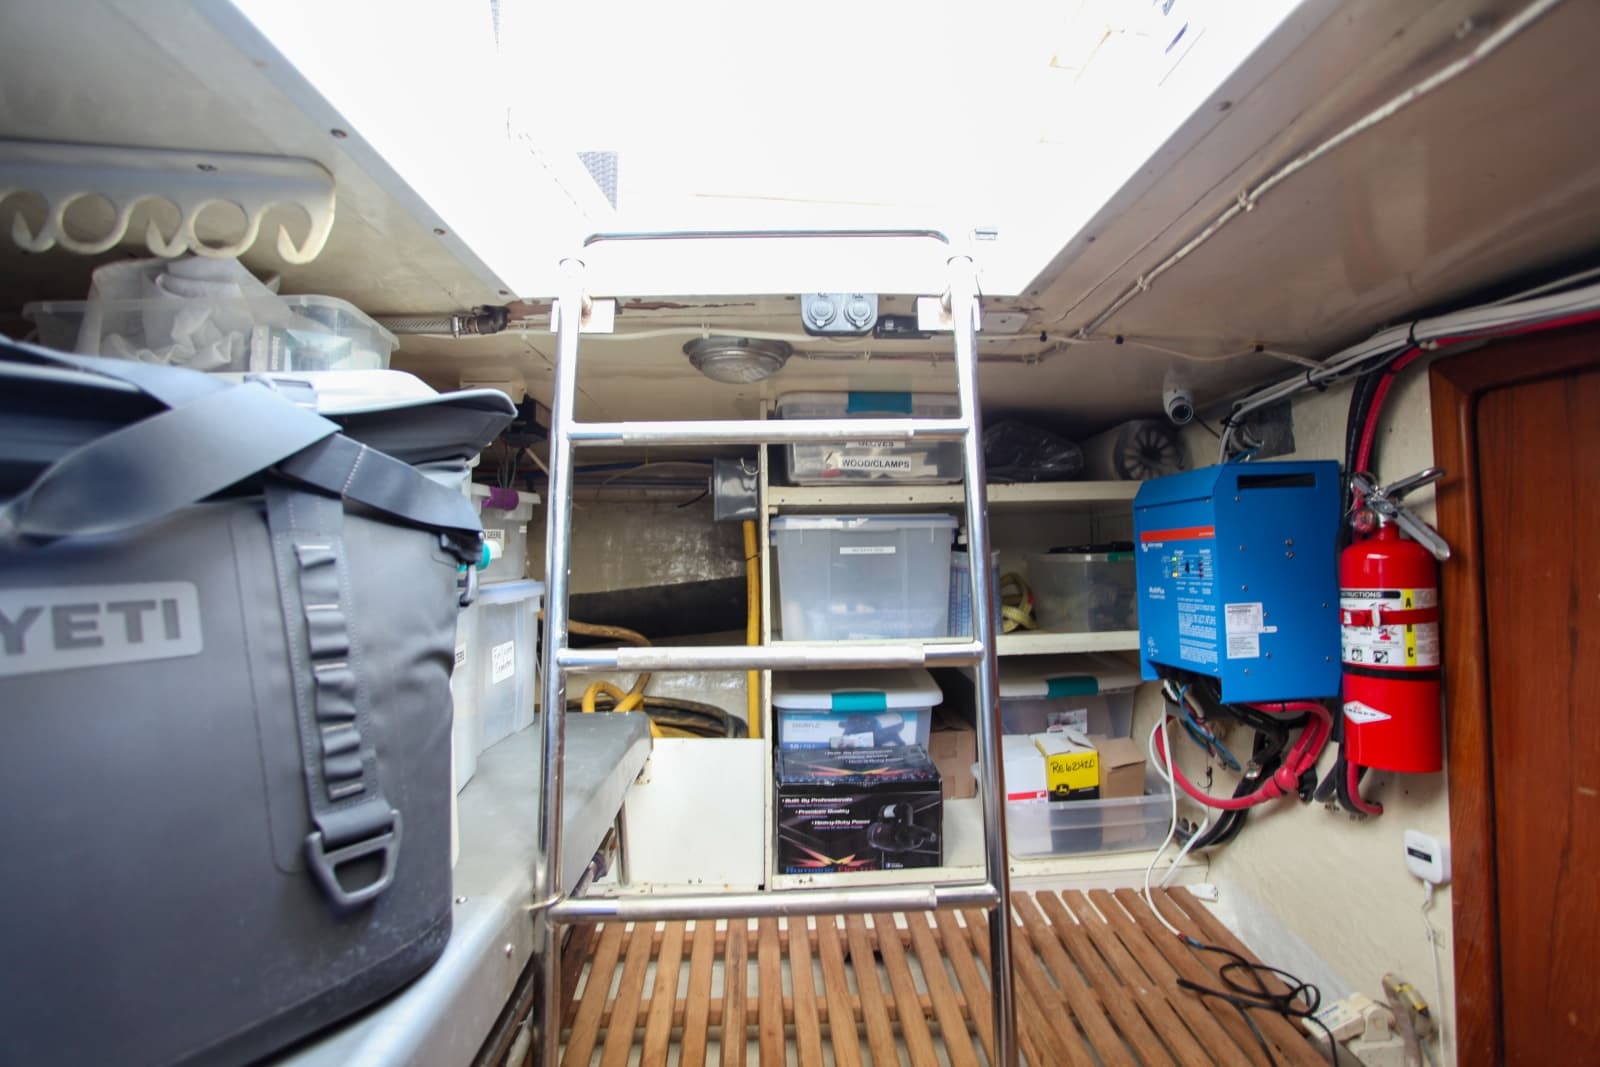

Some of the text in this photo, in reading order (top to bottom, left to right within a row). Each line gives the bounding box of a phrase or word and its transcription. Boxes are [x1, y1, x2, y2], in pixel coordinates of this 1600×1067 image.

[842, 458, 909, 469] WOOD/CLAMPS
[1405, 597, 1412, 609] A
[0, 598, 181, 656] YETI
[1407, 646, 1414, 658] C
